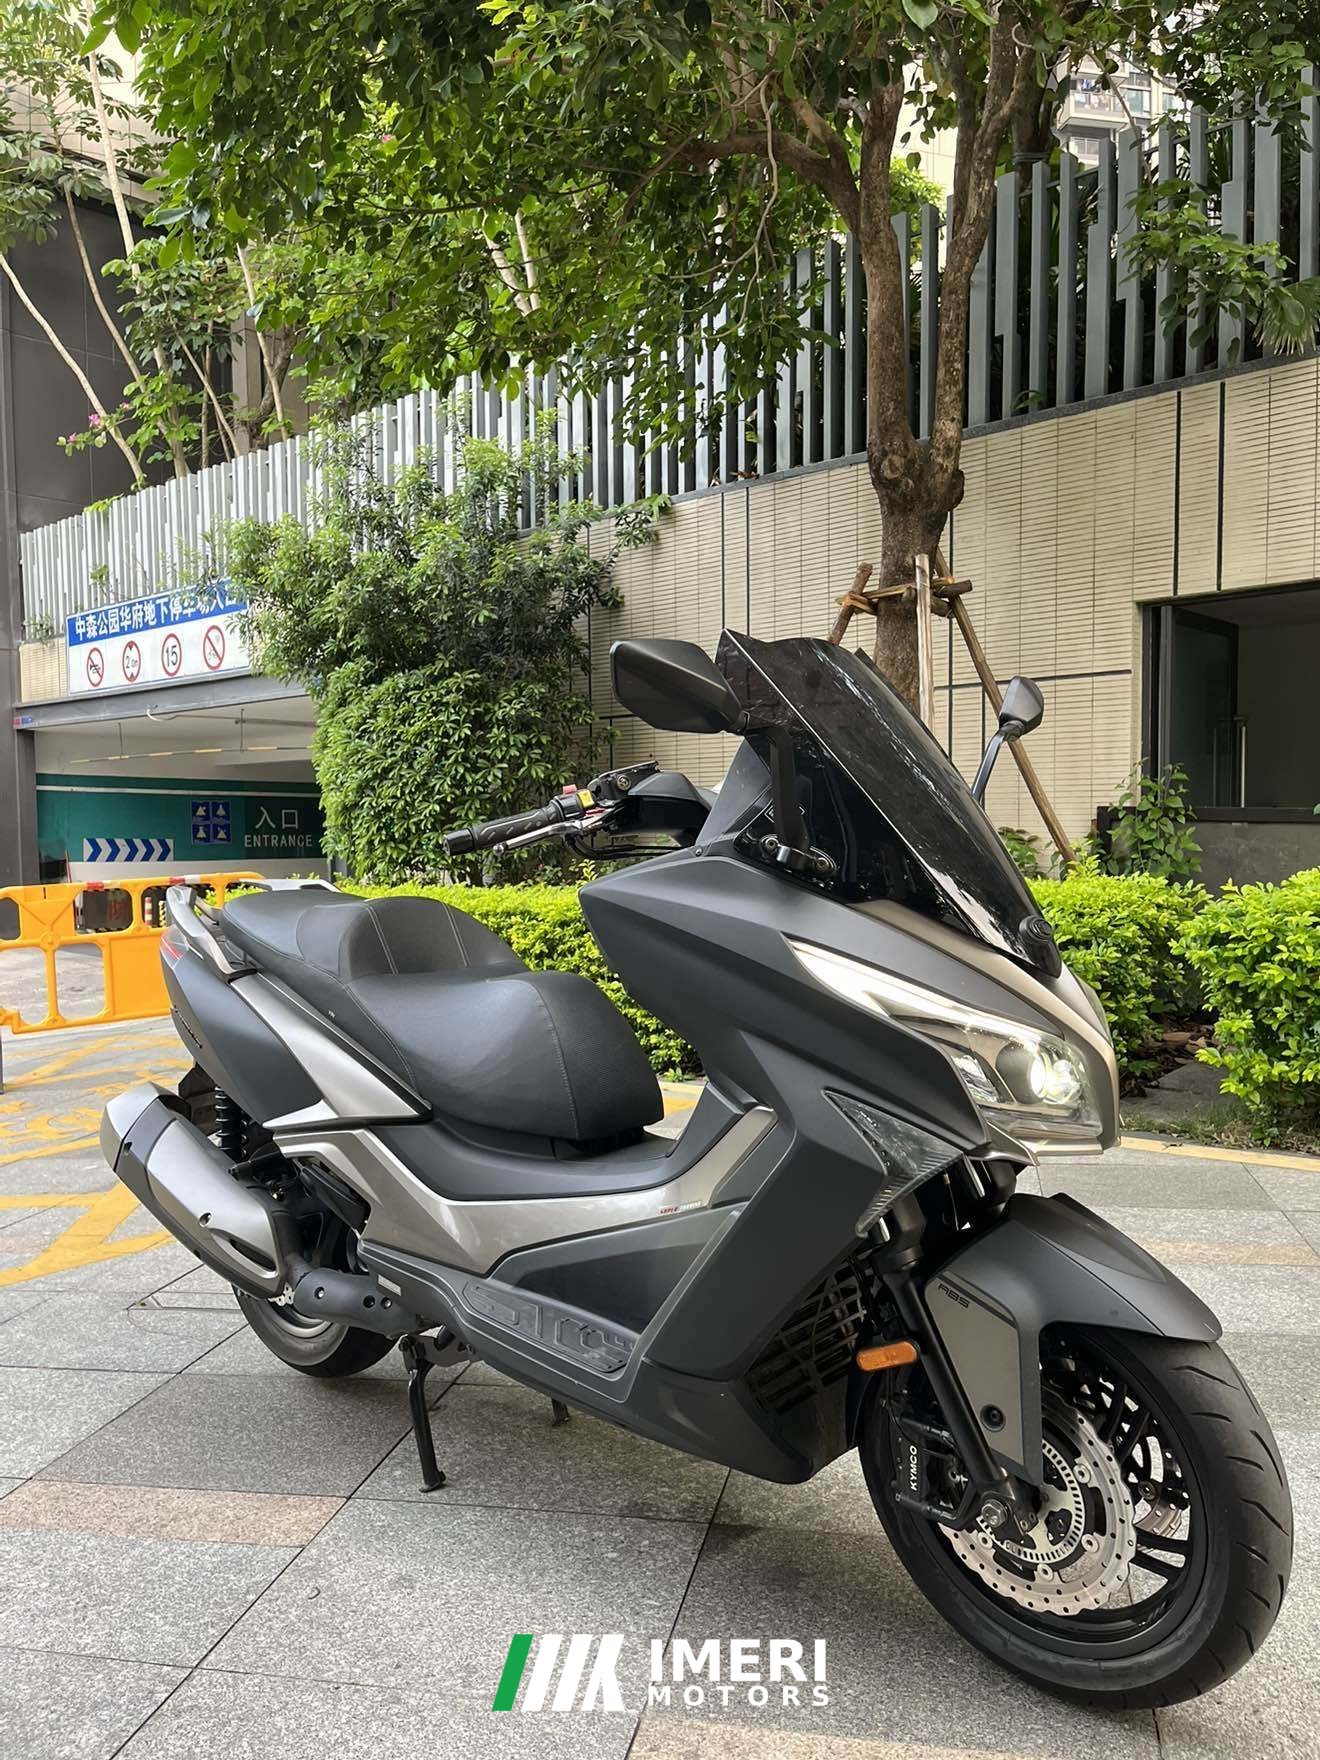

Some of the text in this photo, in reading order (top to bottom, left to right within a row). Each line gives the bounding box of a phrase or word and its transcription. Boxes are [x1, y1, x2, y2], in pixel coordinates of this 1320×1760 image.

[166, 645, 178, 667] 15
[255, 806, 298, 829] 入口
[244, 834, 312, 847] ENTRANCE
[938, 1283, 970, 1308] ABS
[909, 1444, 918, 1491] KYMCO
